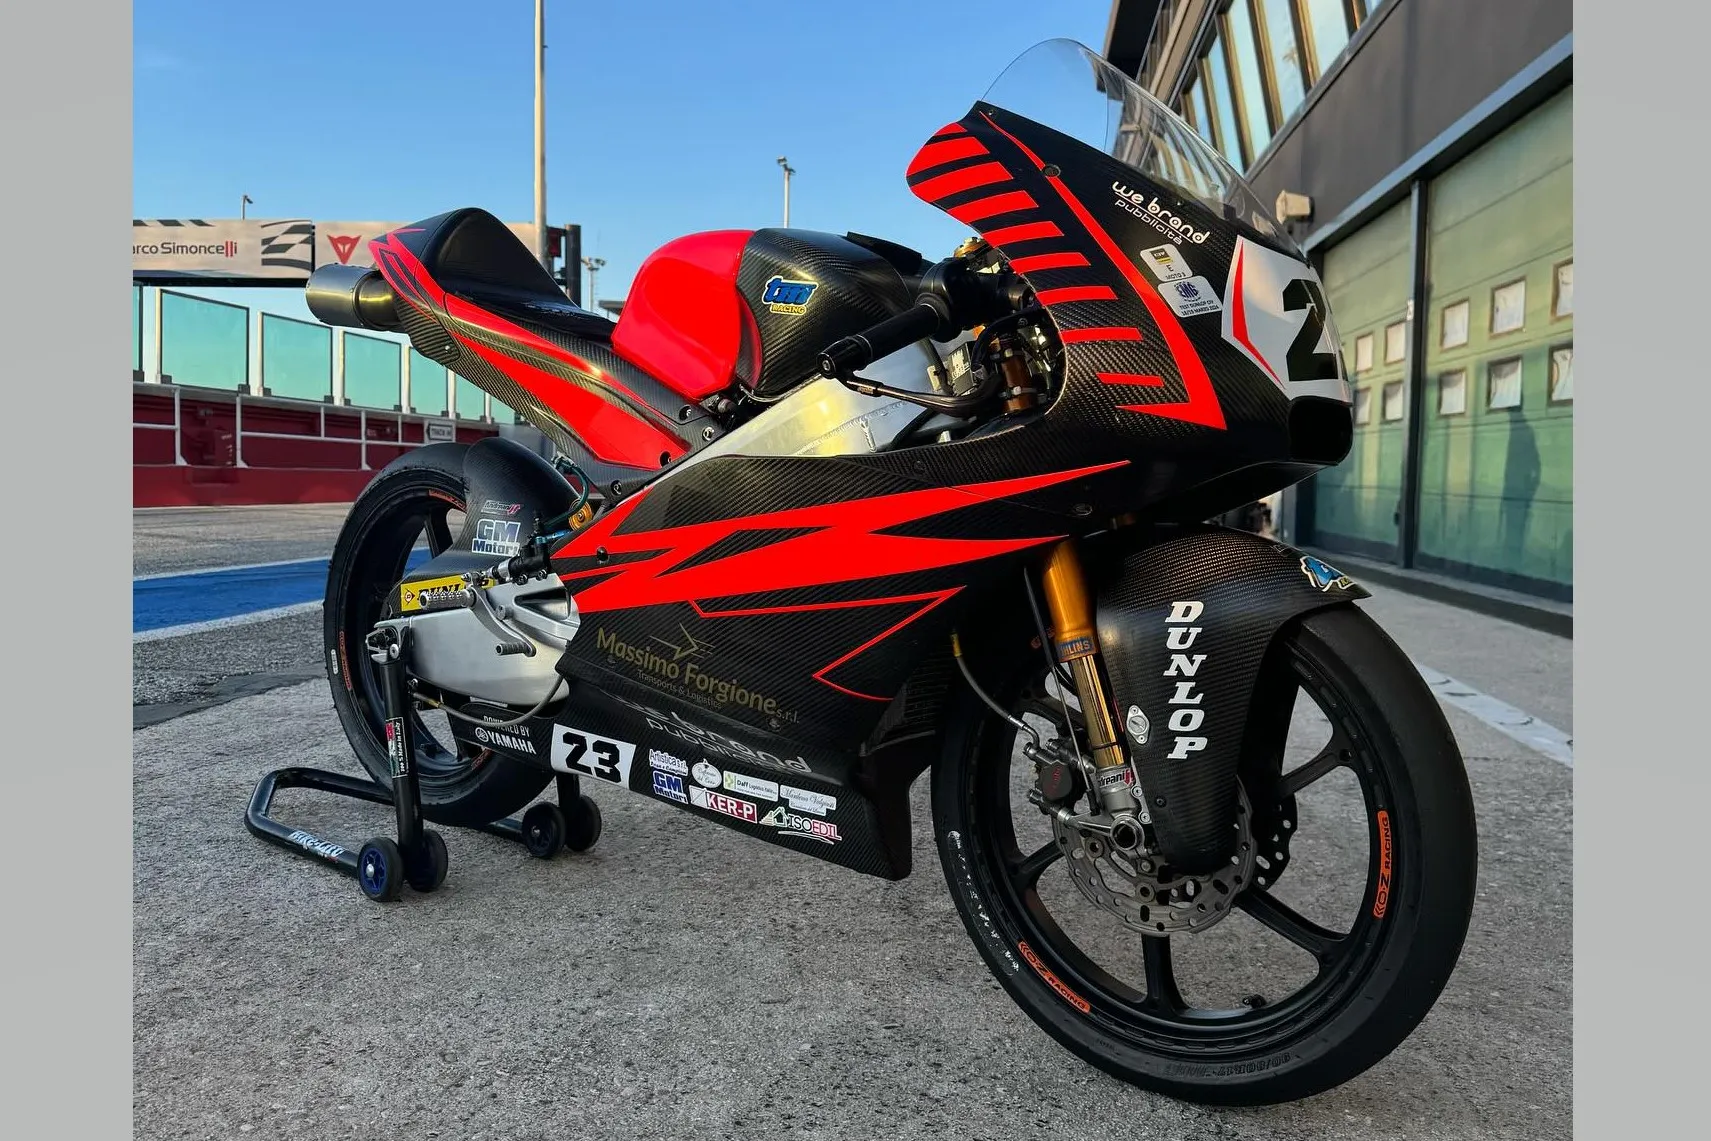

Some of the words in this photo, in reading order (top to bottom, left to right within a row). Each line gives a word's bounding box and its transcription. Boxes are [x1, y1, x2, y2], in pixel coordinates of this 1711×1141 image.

[1112, 181, 1144, 204] we
[1147, 197, 1210, 244] brand
[133, 244, 159, 254] rco
[161, 240, 237, 258] Simoncelli
[772, 304, 805, 314] RACING
[1283, 279, 1338, 382] 2
[477, 519, 520, 542] GM
[597, 627, 680, 679] Massimo
[684, 663, 776, 714] Forgione
[1163, 601, 1207, 760] DUNLOP
[487, 730, 537, 755] YAMAHA
[520, 725, 530, 737] BY
[563, 731, 622, 783] 23
[653, 771, 682, 793] GM
[706, 793, 754, 819] KER-P
[788, 814, 841, 840] ISOEDIL
[1382, 817, 1391, 869] RACING
[1048, 977, 1086, 1010] RACING
